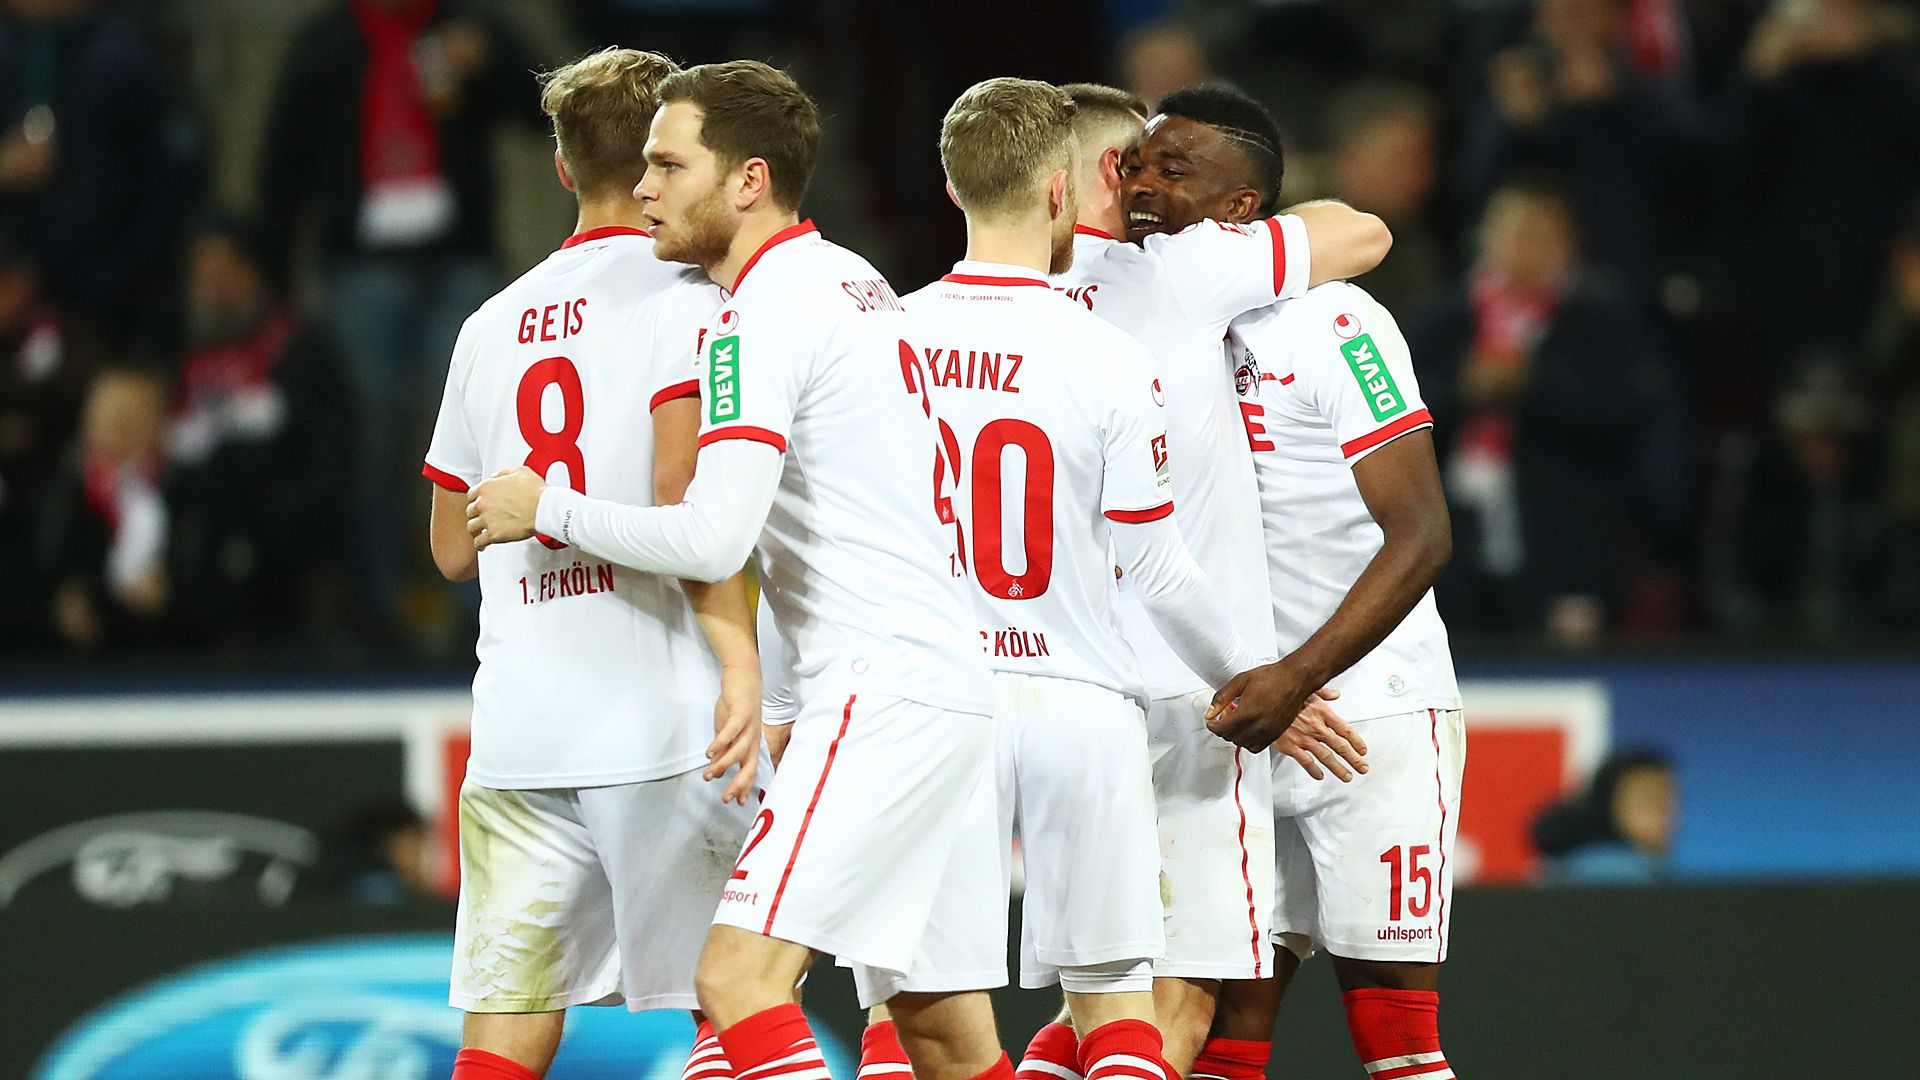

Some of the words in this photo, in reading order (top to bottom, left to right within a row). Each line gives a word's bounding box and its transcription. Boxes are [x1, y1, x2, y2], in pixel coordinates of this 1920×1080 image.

[518, 298, 587, 344] GEIS
[714, 343, 734, 416] DEVK
[925, 348, 1023, 393] KAINZ
[1349, 342, 1398, 414] DEVK
[516, 356, 587, 551] 8
[519, 577, 534, 605] 1.
[540, 571, 556, 602] FC
[560, 561, 615, 597] KÖLN
[995, 626, 1050, 657] KÖLN
[730, 808, 774, 880] 2
[721, 890, 758, 906] sport
[1380, 845, 1431, 921] 15
[1377, 925, 1432, 942] uhlsport
